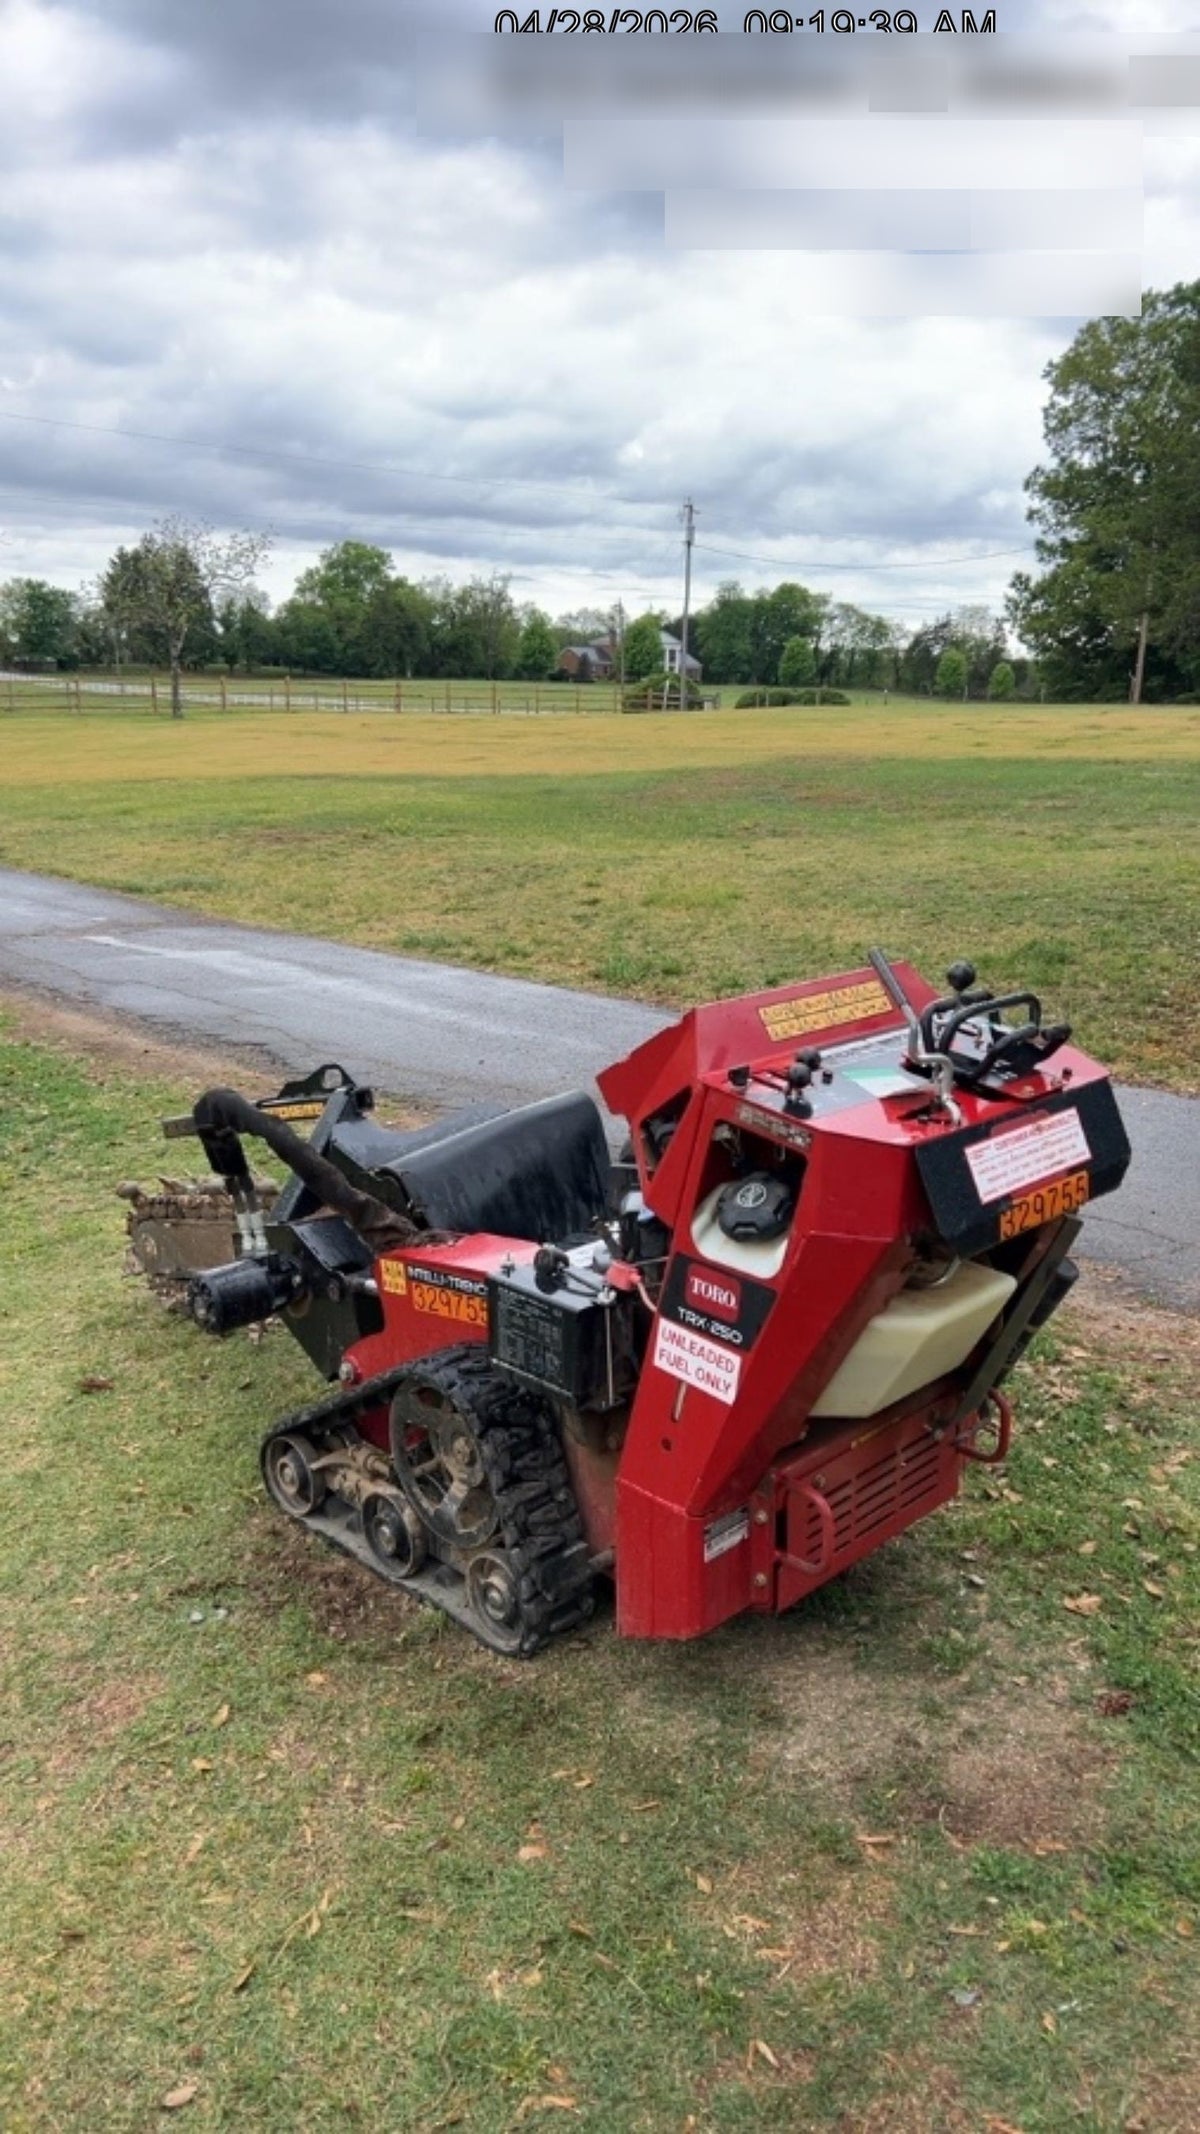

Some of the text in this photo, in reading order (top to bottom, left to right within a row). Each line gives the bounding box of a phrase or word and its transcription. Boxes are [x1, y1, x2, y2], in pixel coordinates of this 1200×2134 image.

[1001, 1174, 1087, 1239] 329755
[690, 1275, 738, 1308] TORO
[659, 1348, 732, 1395] FUEL ONLY
[661, 1326, 735, 1374] UNLEADED
